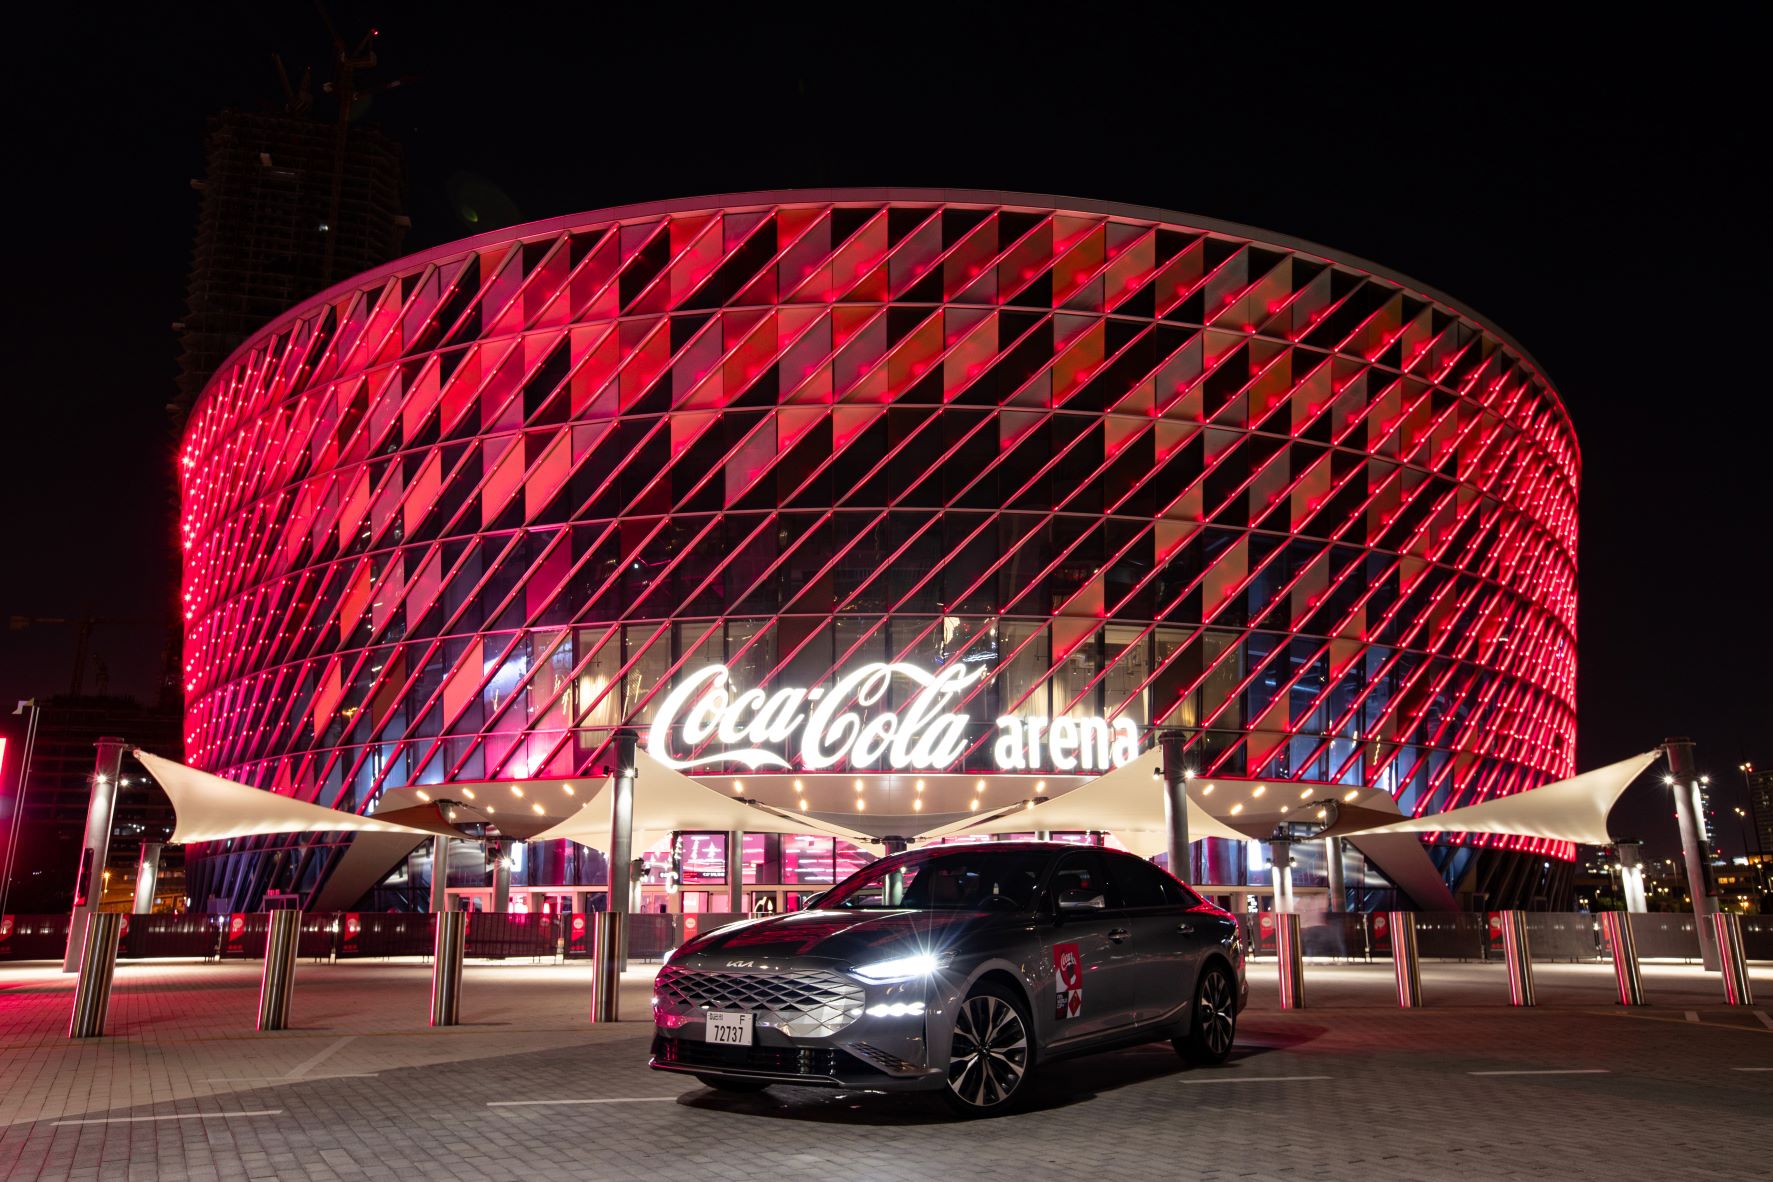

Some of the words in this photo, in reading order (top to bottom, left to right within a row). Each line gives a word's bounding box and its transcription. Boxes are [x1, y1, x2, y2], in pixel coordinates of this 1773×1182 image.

[647, 662, 988, 770] Coca-Cola
[994, 715, 1139, 770] arena
[726, 960, 754, 968] KIA
[739, 1014, 746, 1025] F
[714, 1025, 744, 1043] 72737
